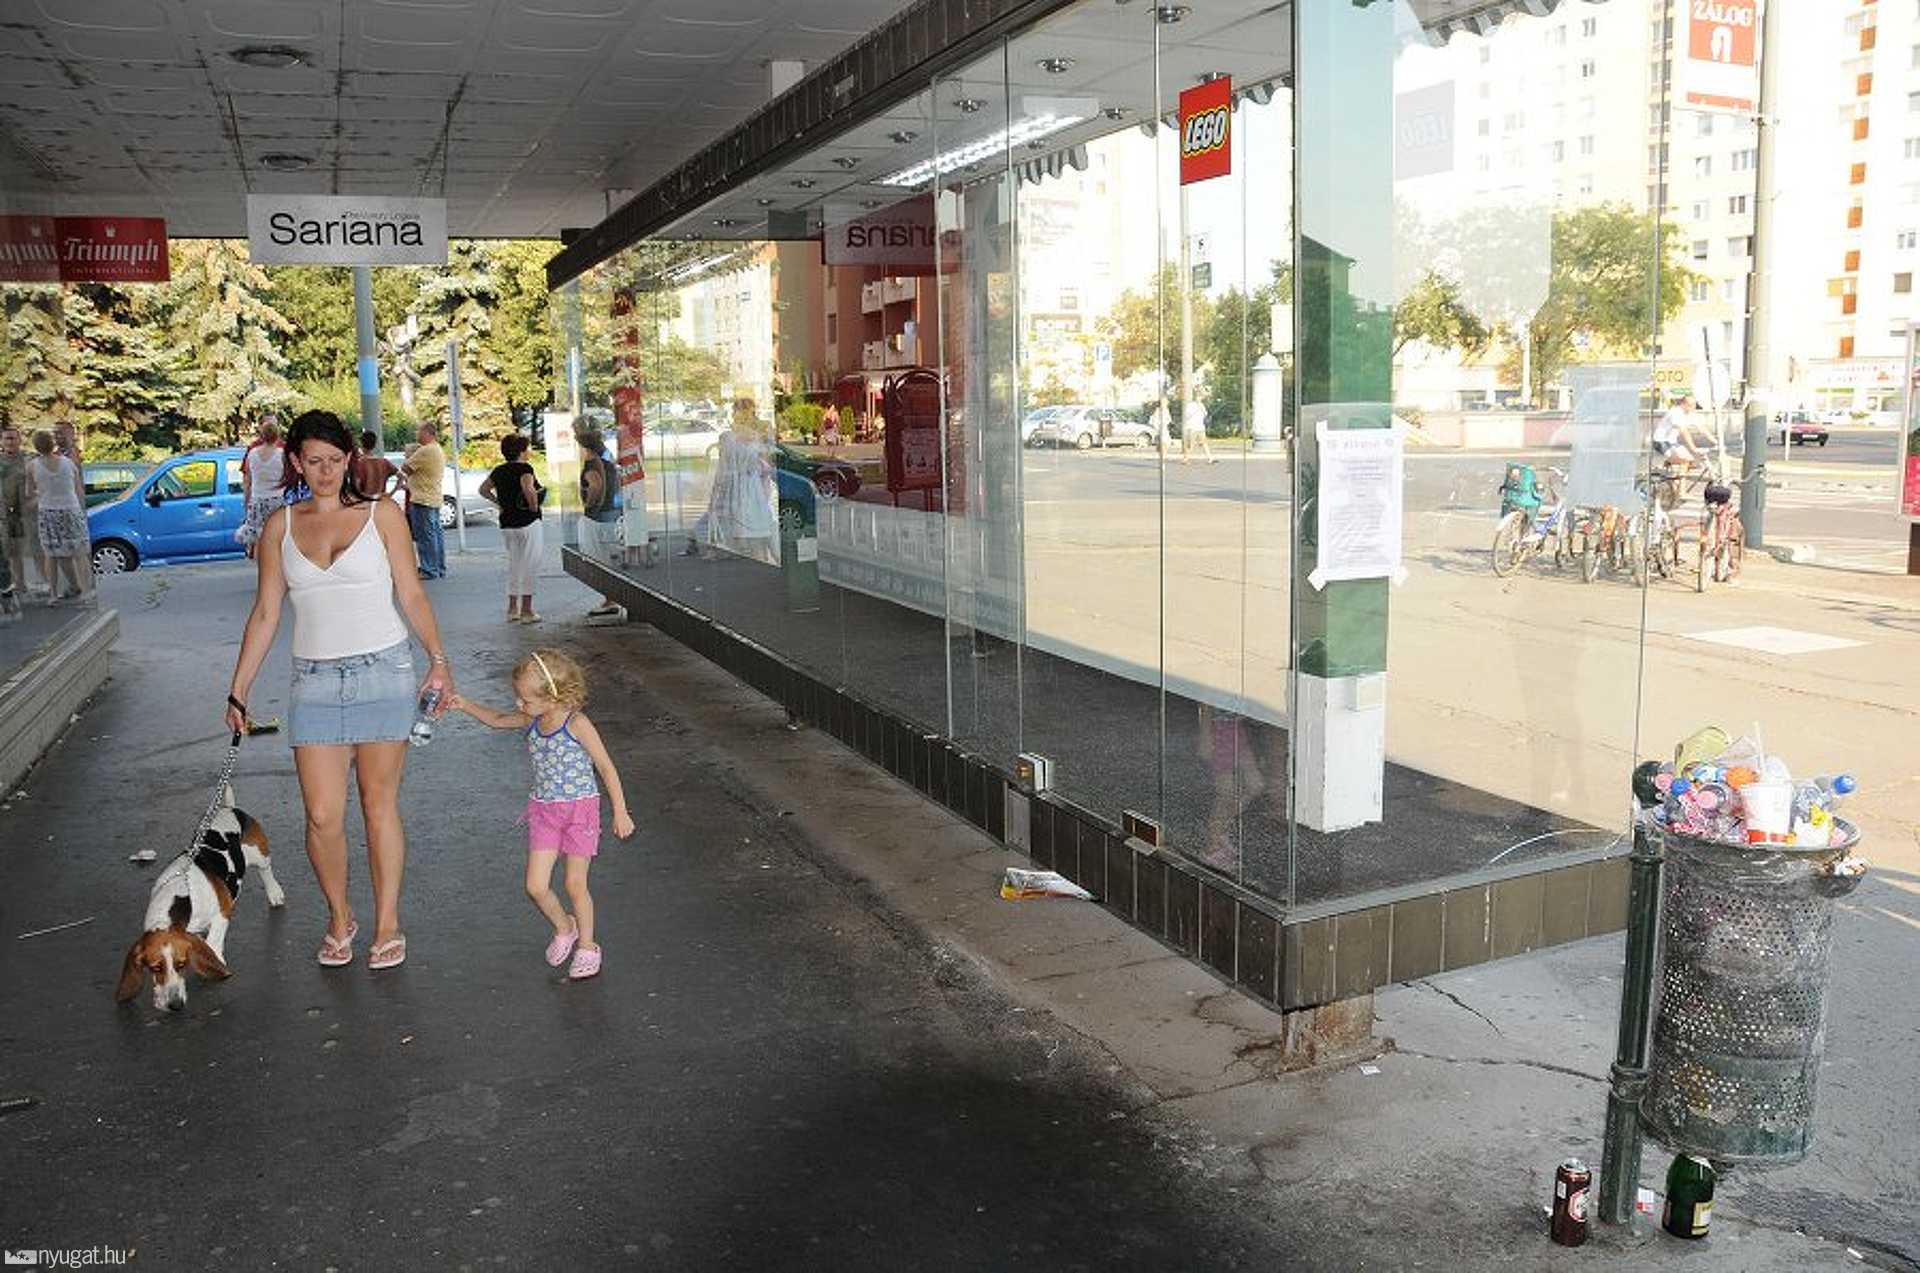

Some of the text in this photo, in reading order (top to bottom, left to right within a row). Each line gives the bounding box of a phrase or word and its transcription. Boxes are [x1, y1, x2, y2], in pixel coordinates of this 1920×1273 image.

[1184, 107, 1228, 155] LEGO
[270, 213, 423, 246] Sariana
[63, 238, 160, 266] Triumph
